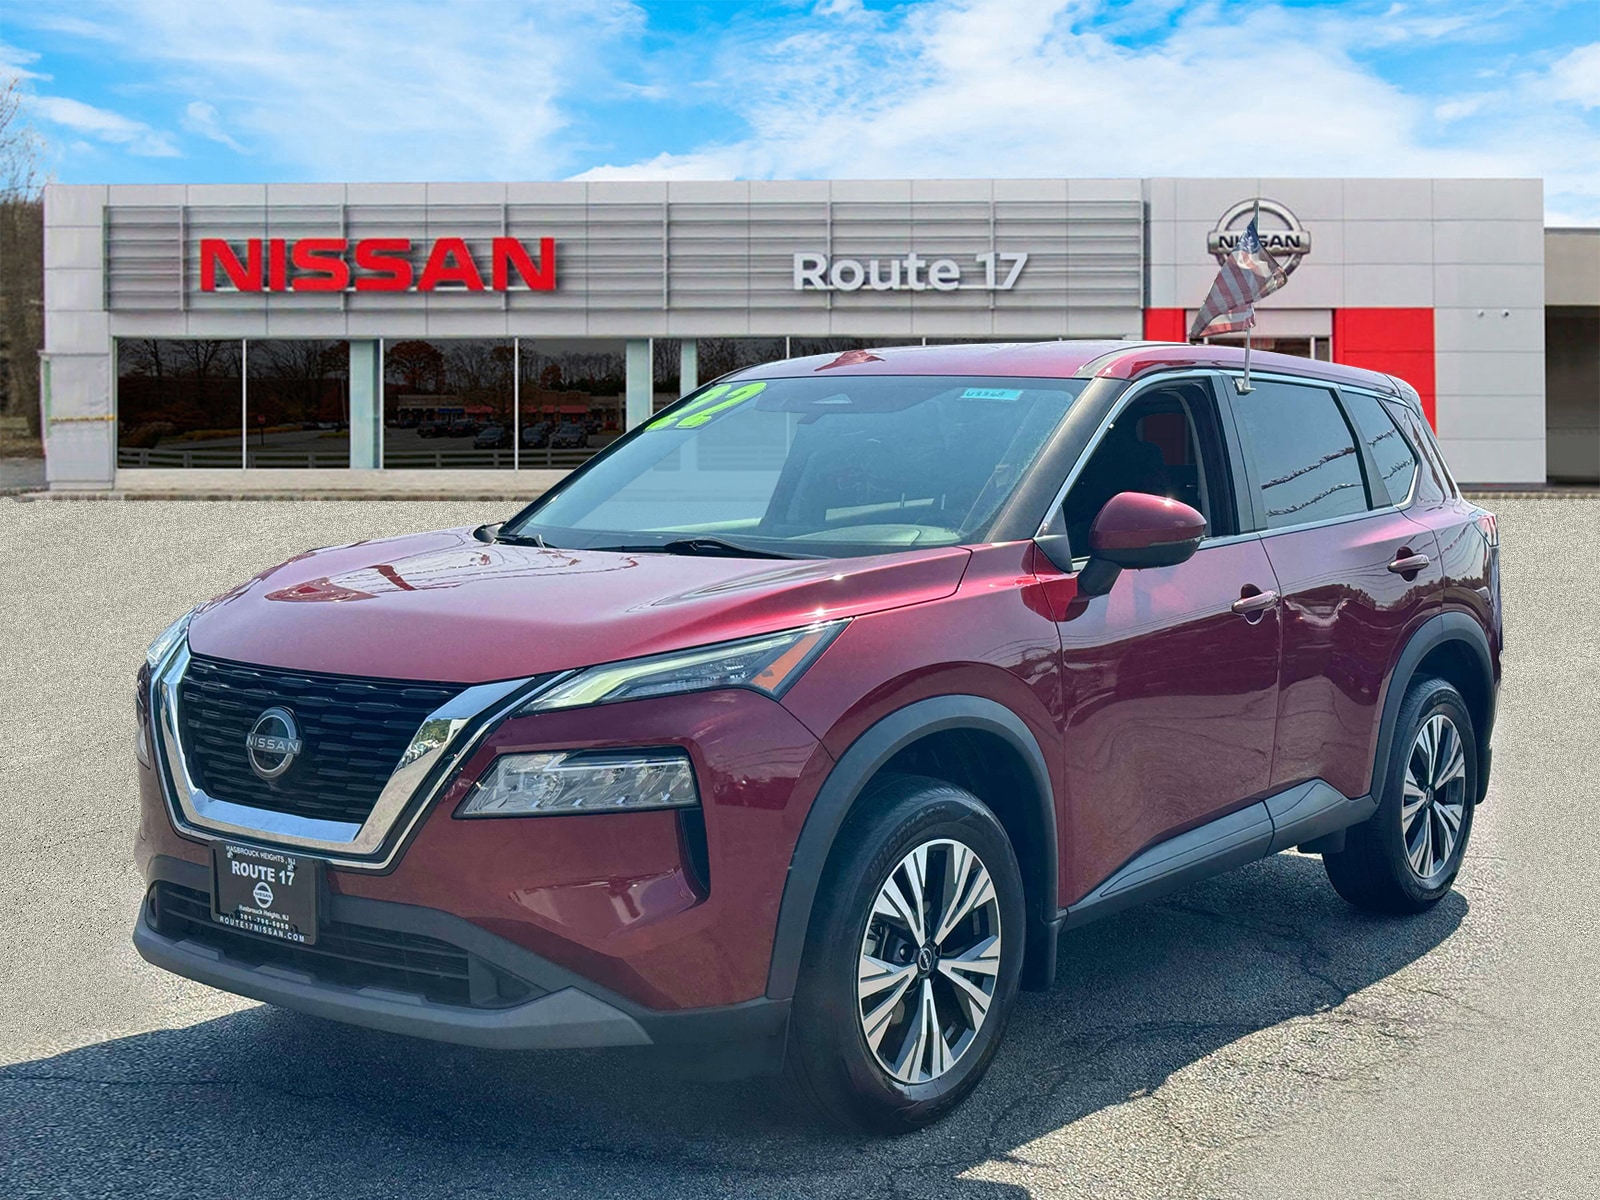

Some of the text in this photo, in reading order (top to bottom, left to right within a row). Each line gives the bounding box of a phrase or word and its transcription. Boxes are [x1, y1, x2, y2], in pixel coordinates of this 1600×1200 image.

[200, 237, 556, 292] NISSAN
[793, 251, 1029, 291] Route 17
[246, 735, 299, 752] NISSAN
[231, 860, 295, 886] ROUTE 17
[219, 915, 305, 943] ROUTE17NISSAN.COM
